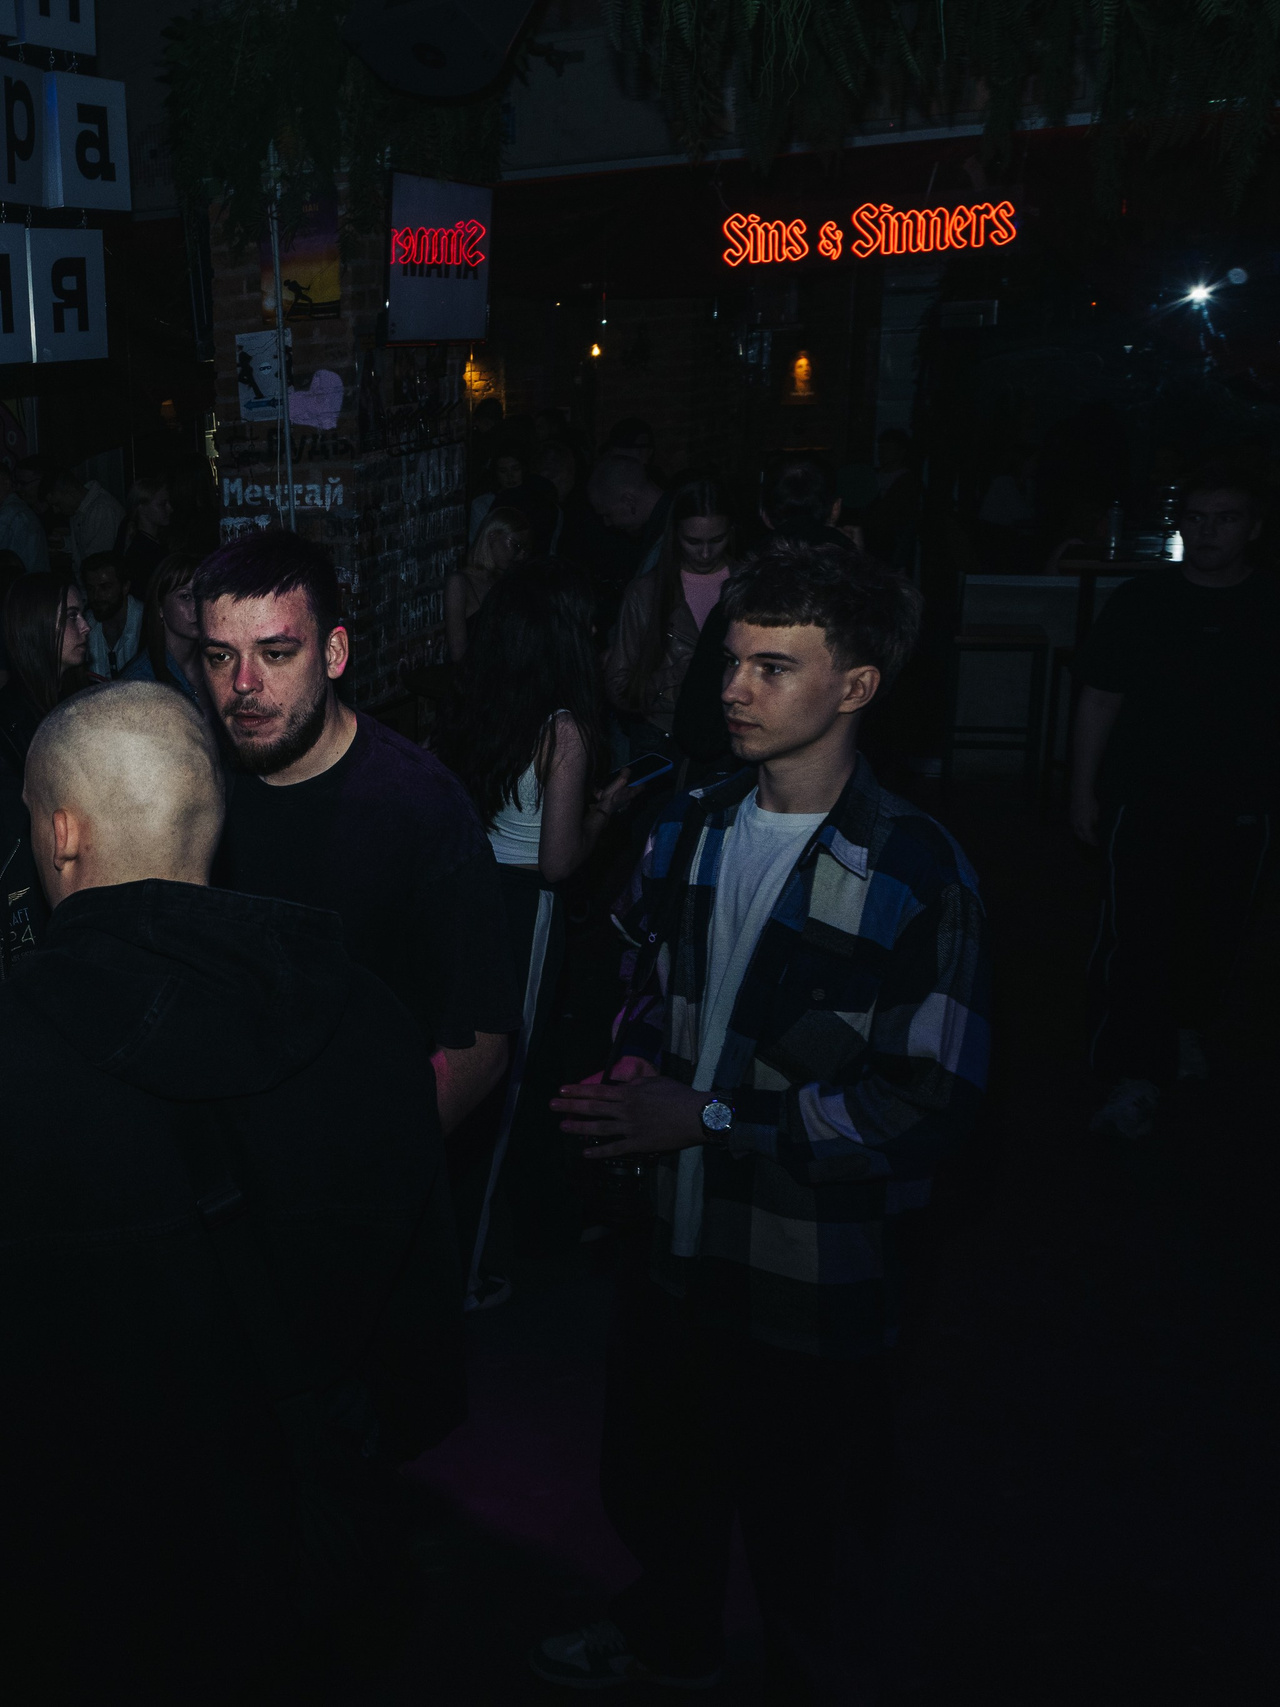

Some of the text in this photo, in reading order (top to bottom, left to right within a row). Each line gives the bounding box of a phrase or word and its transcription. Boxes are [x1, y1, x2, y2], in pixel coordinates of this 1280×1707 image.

[722, 200, 1017, 267] Sins & Sinners
[222, 476, 344, 511] Мечтай
